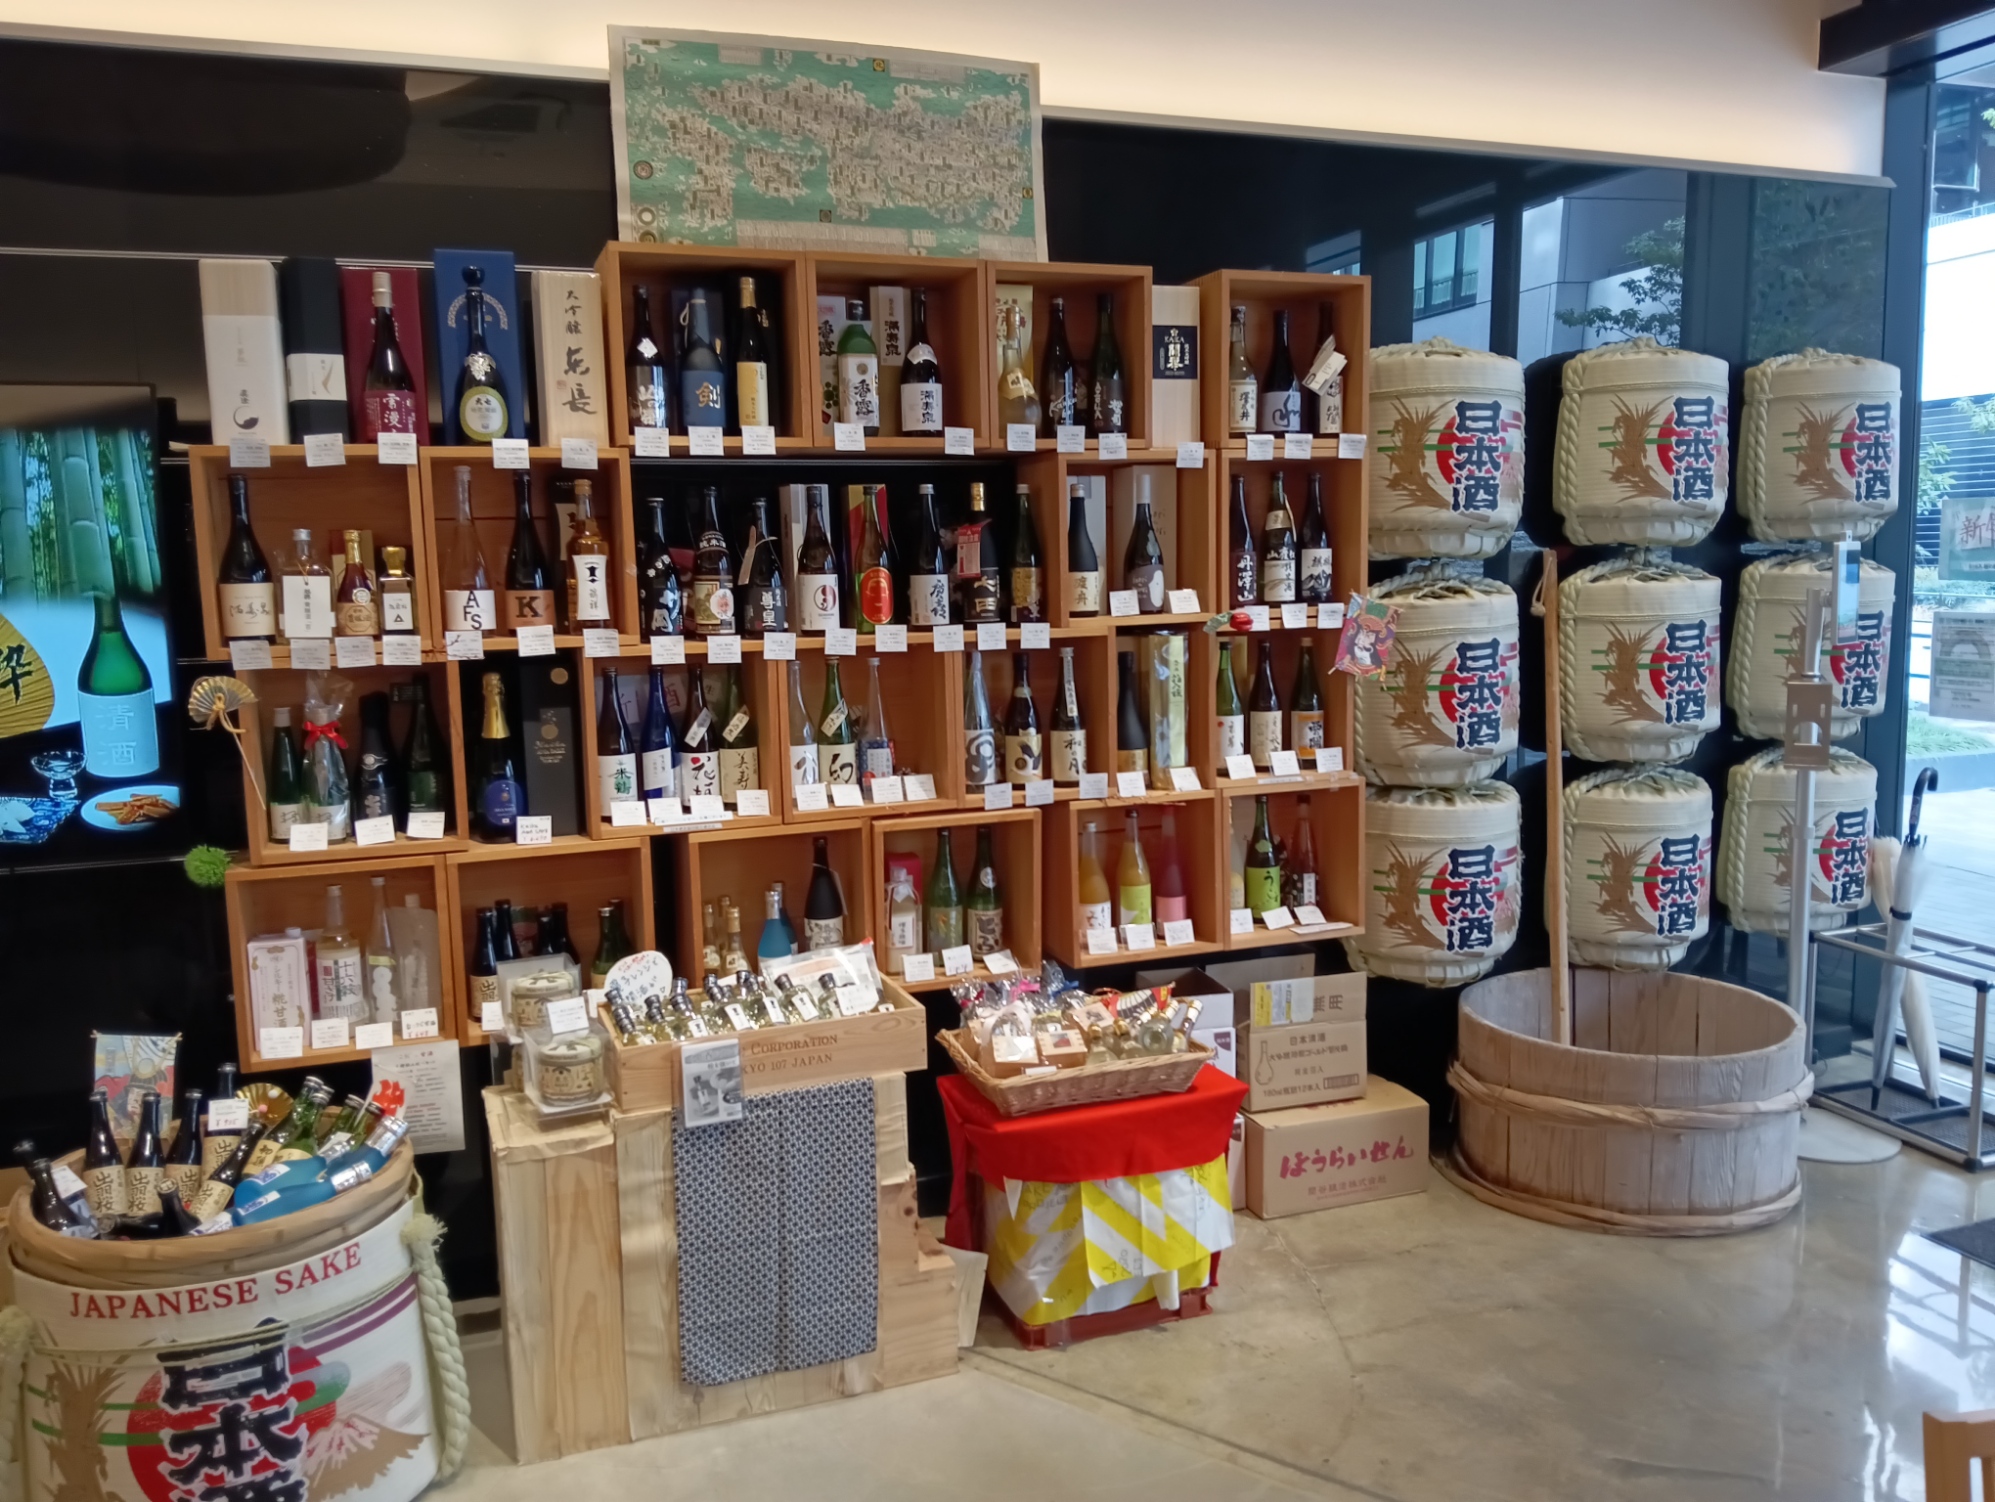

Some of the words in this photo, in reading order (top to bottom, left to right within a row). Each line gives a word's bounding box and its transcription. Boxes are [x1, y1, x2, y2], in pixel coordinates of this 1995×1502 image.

[1454, 400, 1502, 512] 日本酒
[1672, 396, 1715, 501] 日本酒
[1854, 401, 1892, 501] 日本酒
[515, 596, 543, 618] K
[1455, 637, 1502, 749] 日本酒
[1664, 619, 1707, 724] 日本酒
[1841, 611, 1885, 709] 日本酒
[96, 704, 135, 766] 清酒
[1446, 844, 1495, 952] 日本酒
[1657, 834, 1700, 936] 日本酒
[1832, 807, 1868, 905] 日本酒
[751, 1034, 838, 1056] CORPORATION
[791, 1053, 833, 1068] JAPAN
[70, 1278, 259, 1320] JAPANESE
[274, 1242, 363, 1295] SAKE
